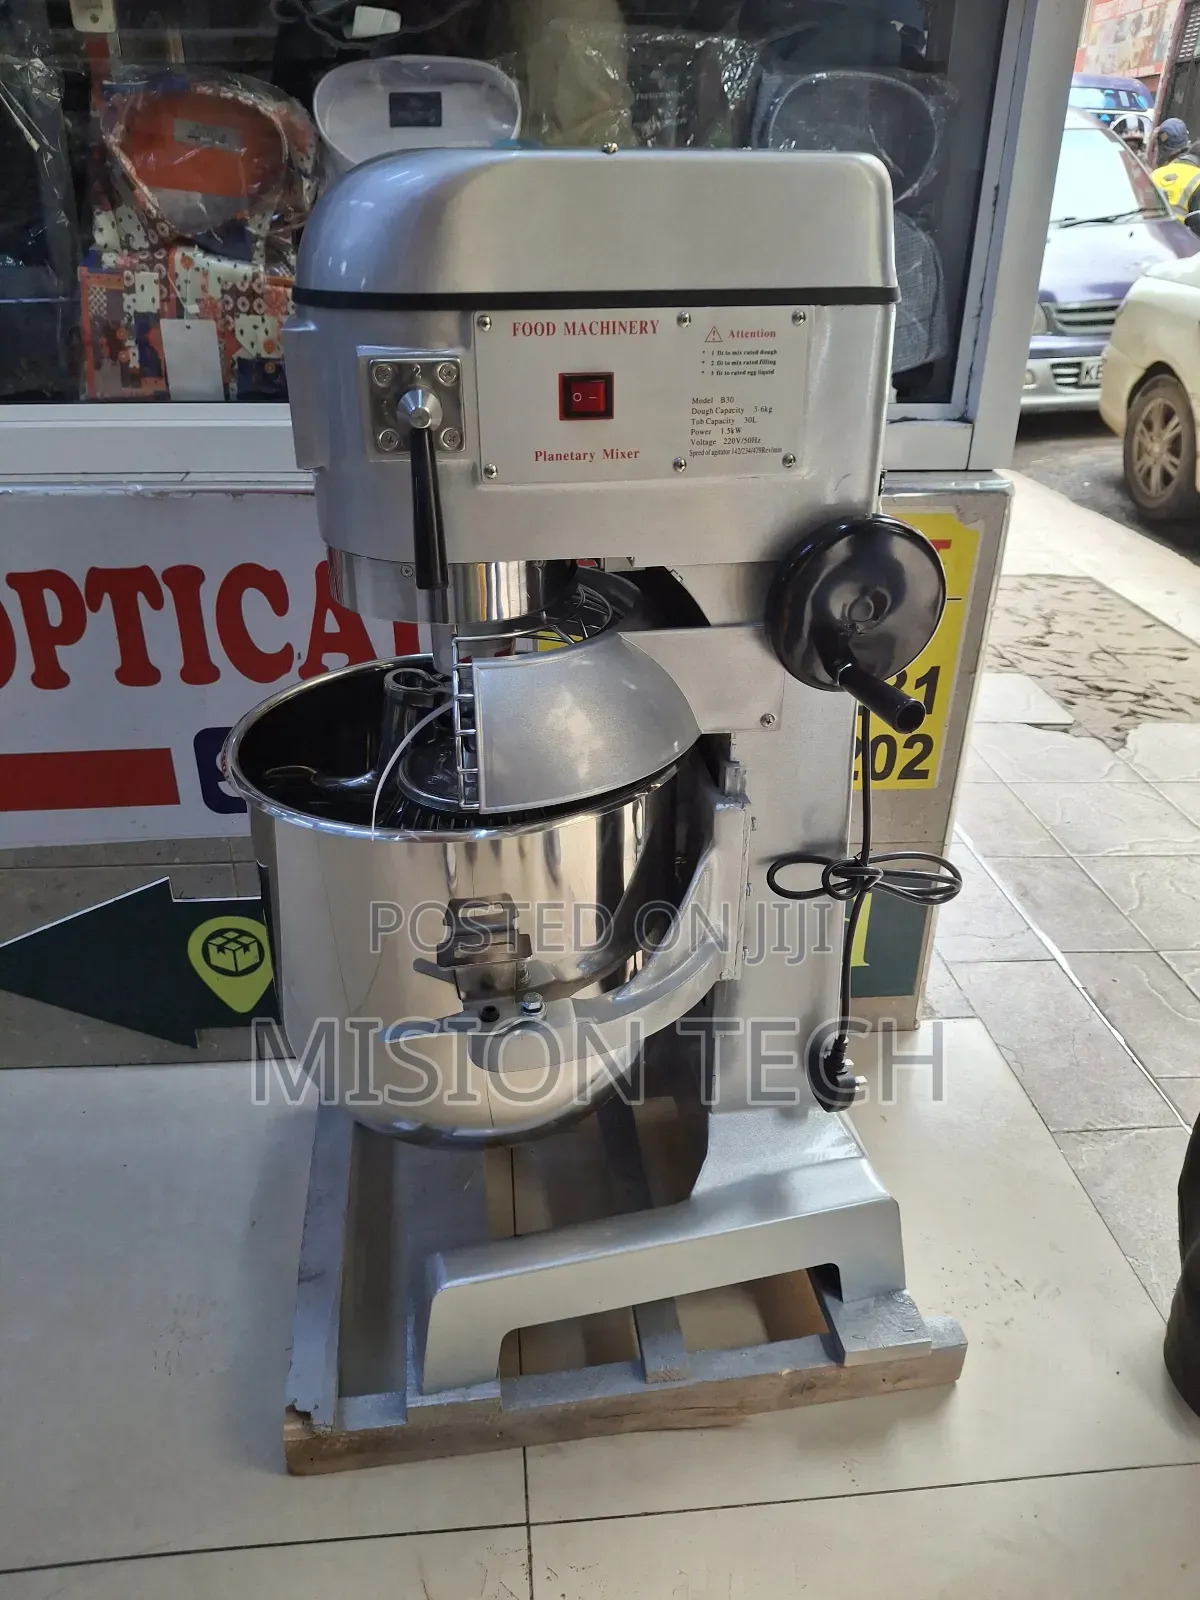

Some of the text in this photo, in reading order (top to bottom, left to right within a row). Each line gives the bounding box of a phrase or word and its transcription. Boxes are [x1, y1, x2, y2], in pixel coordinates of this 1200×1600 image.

[512, 319, 660, 337] FOOD MACHINERY
[728, 328, 777, 339] Attention
[760, 347, 778, 356] dough
[759, 358, 777, 366] filling
[731, 368, 746, 376] rated
[746, 369, 757, 377] egg
[757, 368, 775, 377] liquid
[691, 396, 735, 405] Model B30
[691, 407, 714, 416] Dough
[715, 406, 745, 416] Capacity
[691, 416, 758, 427] Tub Capacity 30L
[690, 426, 743, 436] Power 1.5kW
[690, 436, 762, 447] Voltage 220V/50Hz
[534, 448, 640, 463] Planetary Mixer
[689, 448, 705, 458] Speed
[0, 562, 420, 692] PTICA
